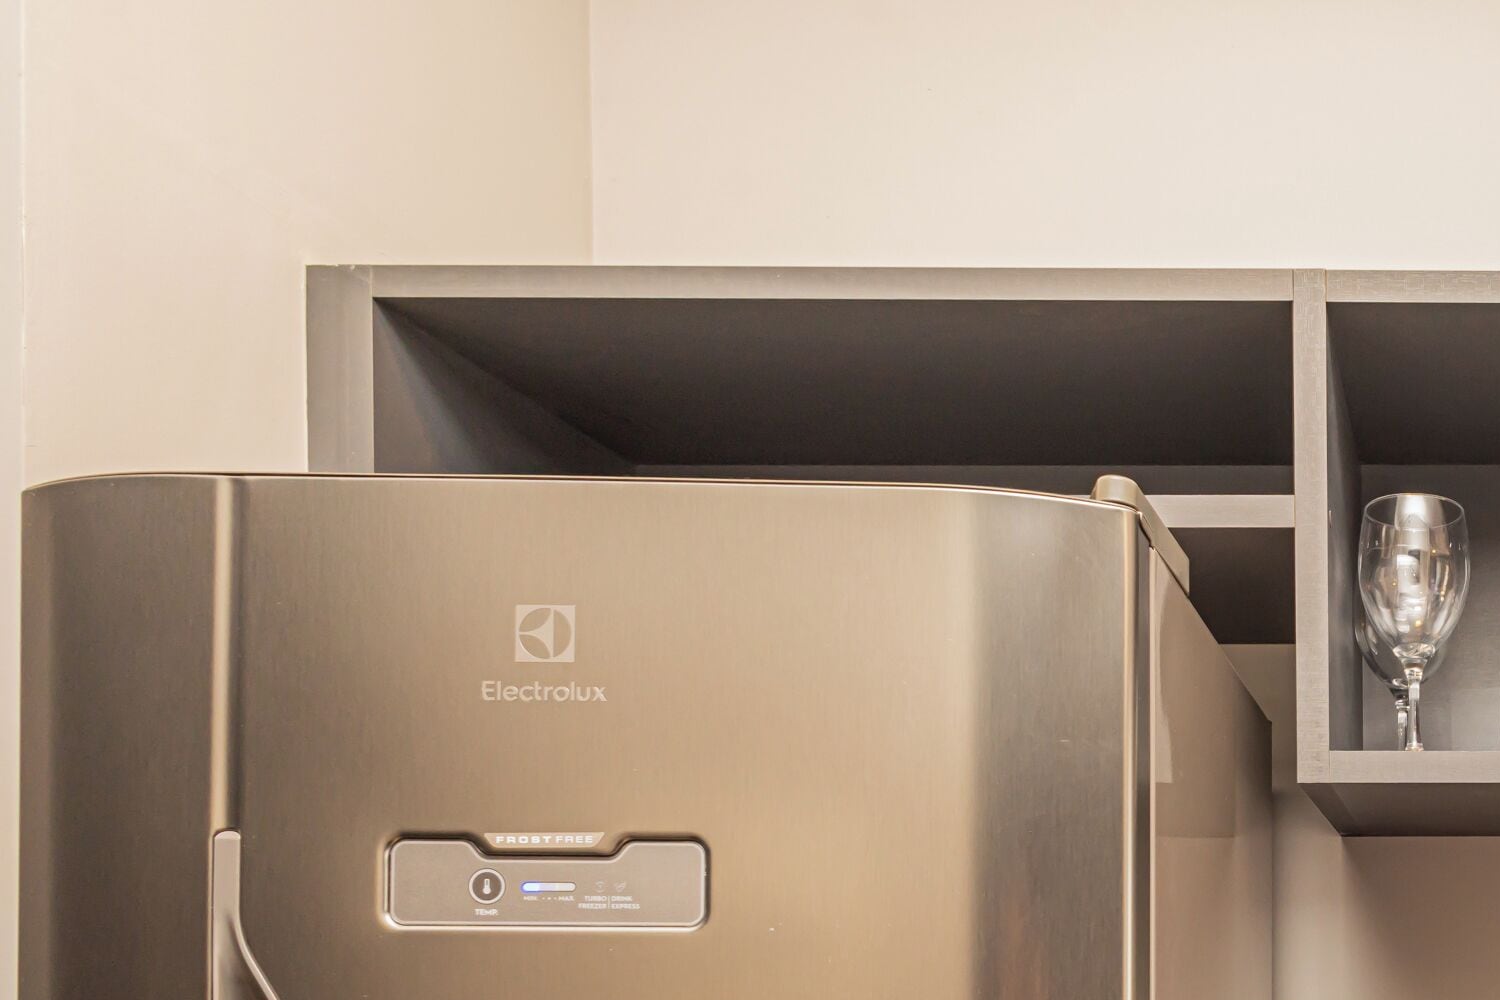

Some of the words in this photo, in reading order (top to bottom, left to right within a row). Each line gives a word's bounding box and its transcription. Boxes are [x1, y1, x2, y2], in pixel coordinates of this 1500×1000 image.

[481, 680, 608, 702] Electrolux
[495, 835, 552, 844] FROST
[556, 835, 593, 844] FREE
